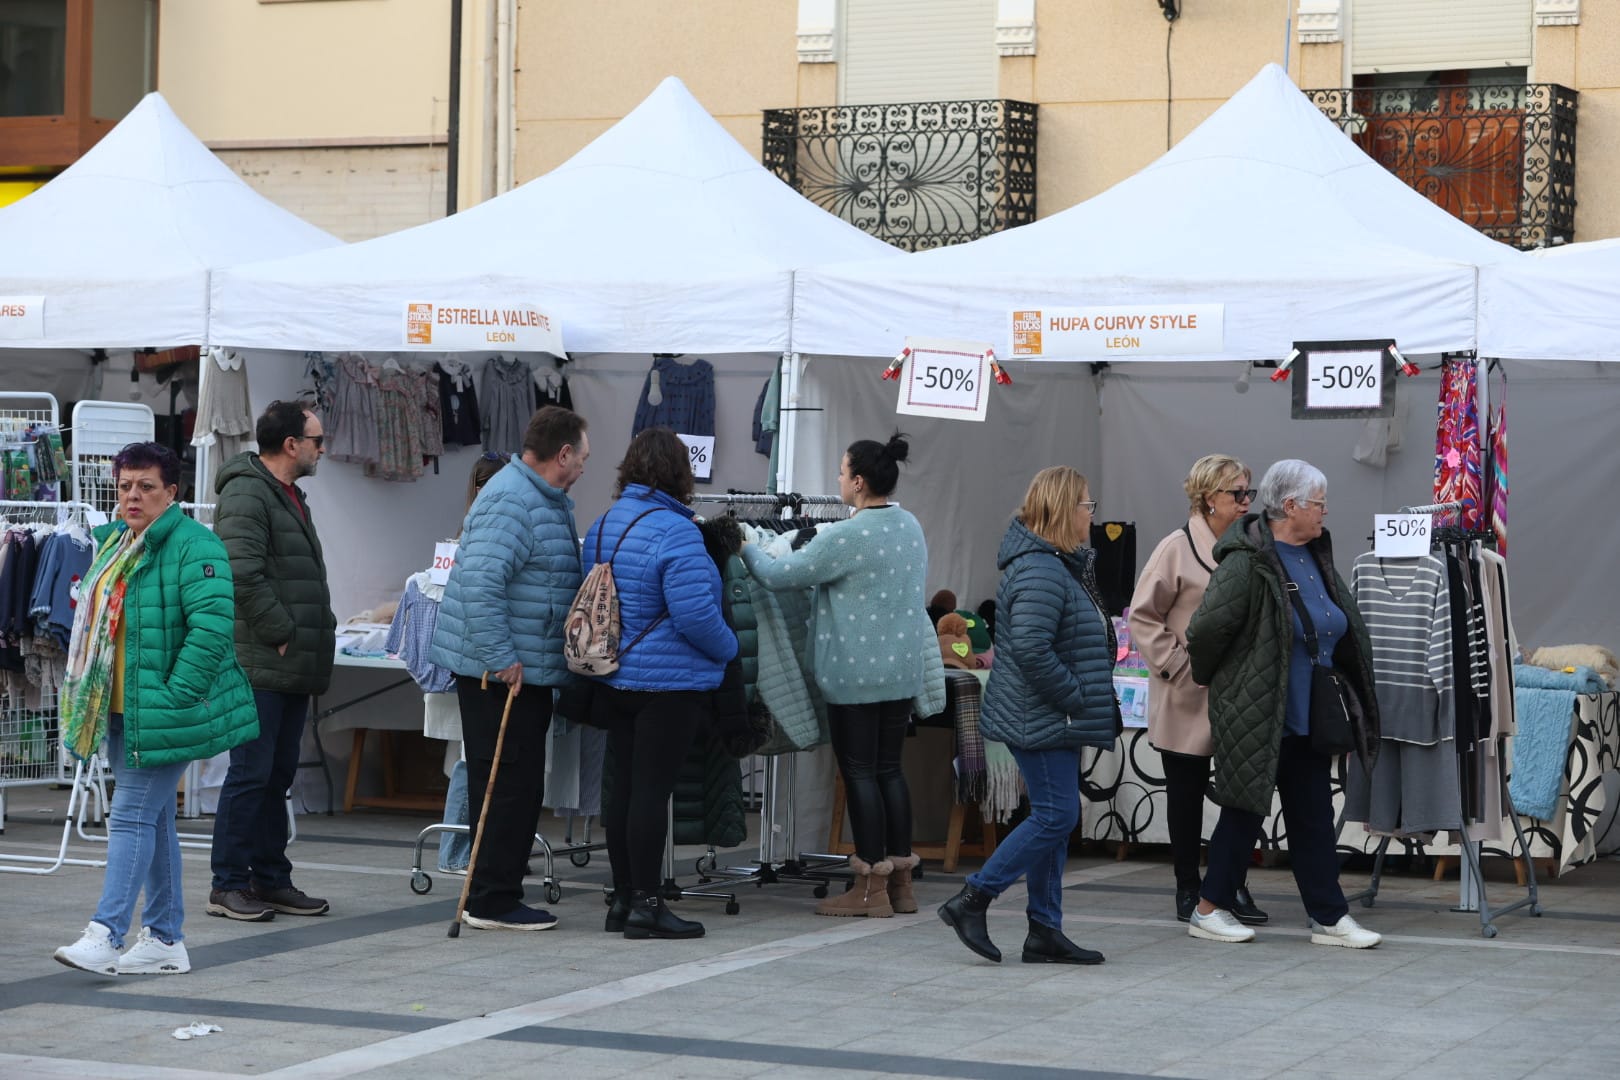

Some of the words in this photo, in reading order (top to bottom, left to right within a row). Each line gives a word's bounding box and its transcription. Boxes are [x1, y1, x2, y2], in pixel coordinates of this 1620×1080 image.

[0, 304, 26, 317] RES
[437, 308, 500, 325] ESTRELLA
[503, 310, 551, 332] VALIENTE
[1014, 320, 1041, 331] STOCKS
[1050, 317, 1090, 331] HUPA
[1094, 315, 1146, 330] CURVY
[1149, 314, 1197, 329] STYLE
[486, 331, 516, 343] LEÓN
[1105, 335, 1140, 349] LEÓN
[915, 366, 974, 392] -50%
[1311, 364, 1376, 389] -50%
[1378, 518, 1426, 537] -50%
